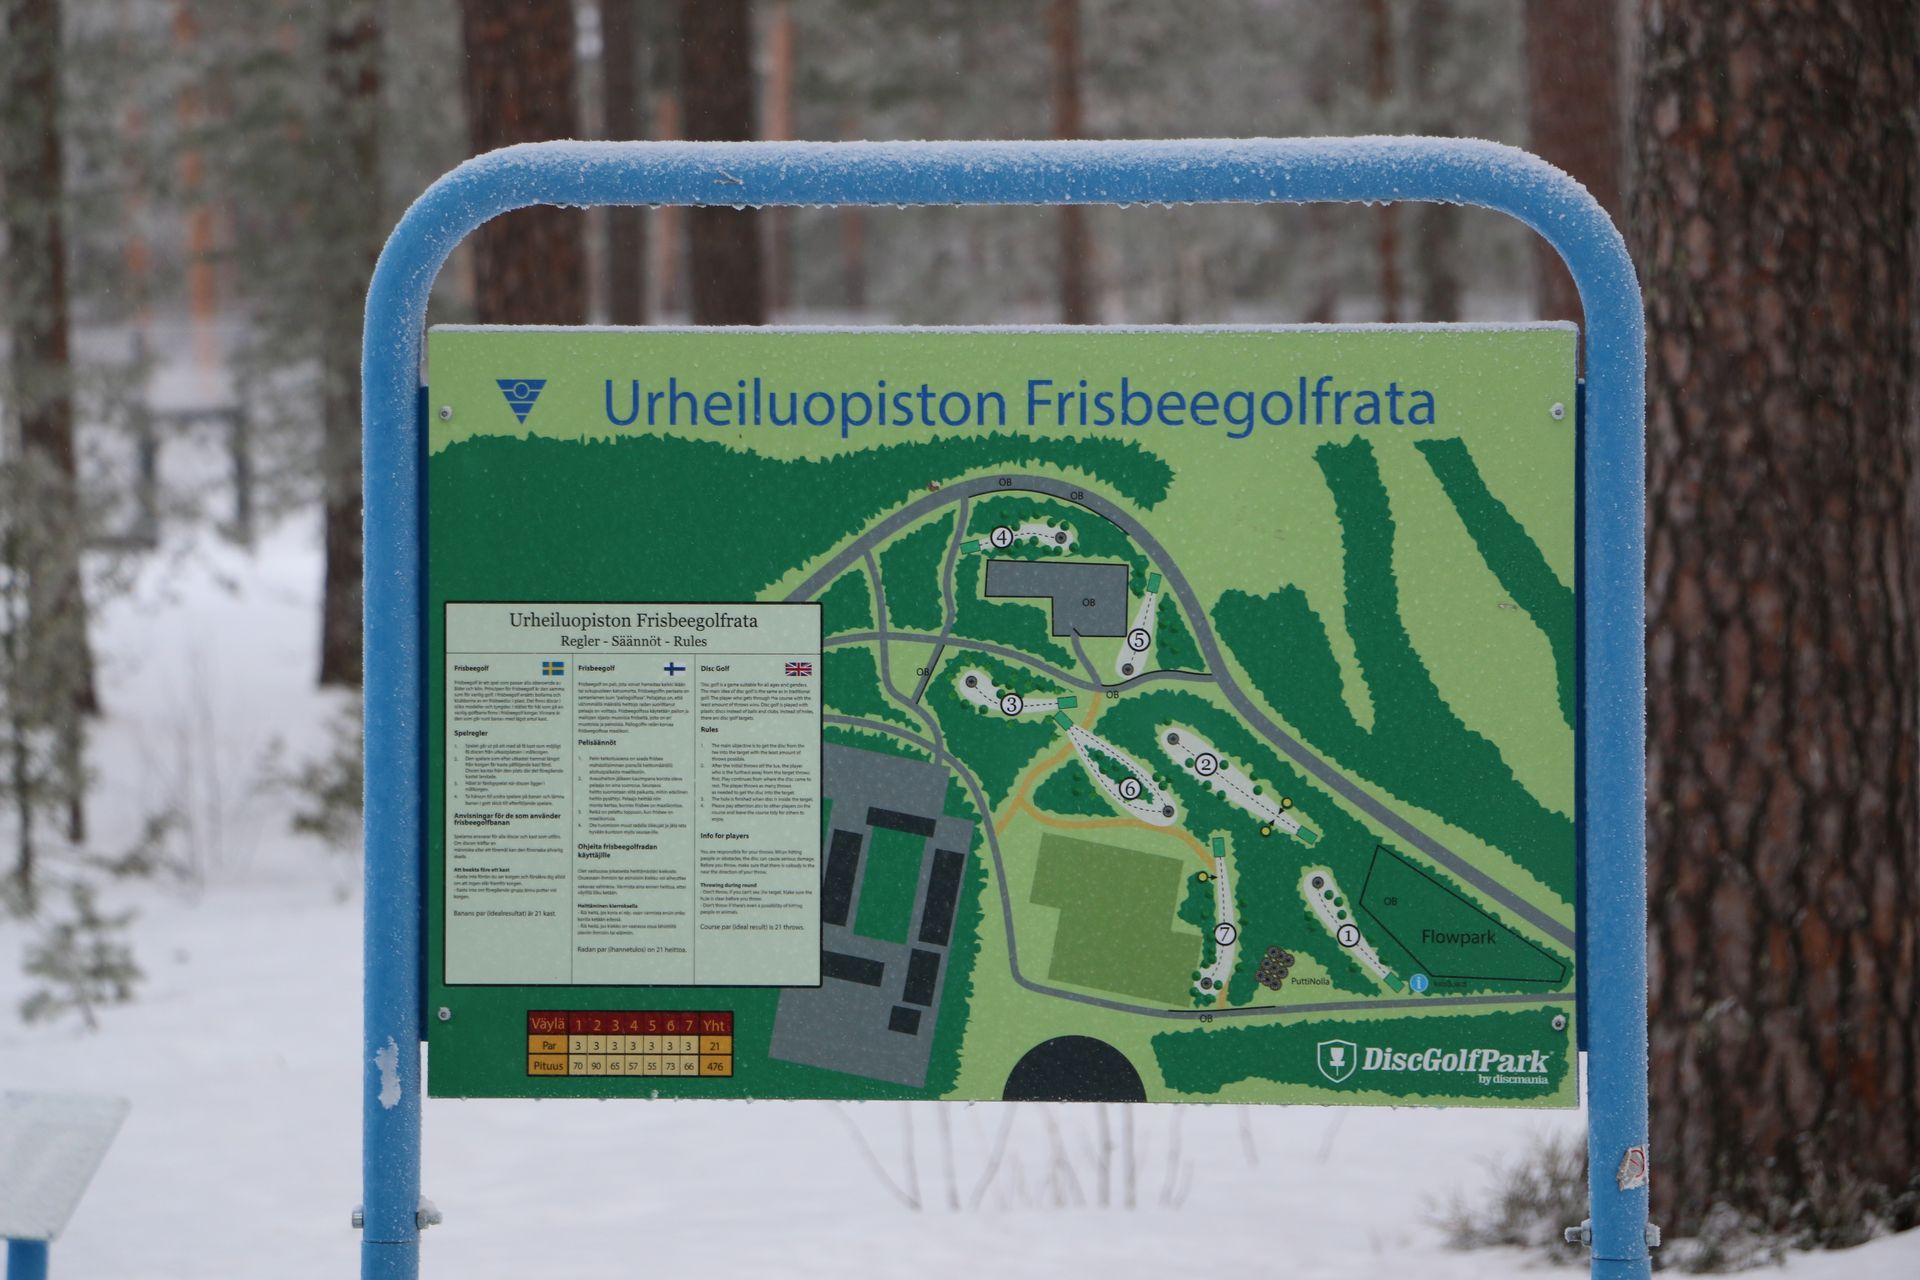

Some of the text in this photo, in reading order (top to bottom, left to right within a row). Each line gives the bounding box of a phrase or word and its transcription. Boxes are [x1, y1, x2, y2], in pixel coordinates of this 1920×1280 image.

[605, 376, 1435, 439] Urheiluopiston Frisbeegolfrata
[998, 478, 1012, 487] OB
[1070, 491, 1084, 501] OB
[996, 530, 1007, 545] 4
[1082, 598, 1096, 607] OB
[510, 612, 758, 631] Urheiluopiston Frisbeegolfrata
[561, 636, 600, 648] Regler
[612, 635, 661, 647] Säännöt
[674, 636, 707, 647] Rules
[1134, 633, 1145, 648] 5
[916, 667, 930, 676] OB
[1106, 690, 1119, 699] OB
[1006, 697, 1017, 712] 3
[1201, 759, 1211, 771] 2
[1125, 781, 1136, 796] 6
[1384, 897, 1397, 906] OB
[1220, 928, 1231, 942] 7
[1422, 929, 1496, 948] Flowpark
[531, 1017, 724, 1032] Väylä 1 2 3 4 5 6 7 Yht
[1200, 1015, 1213, 1023] OB
[542, 1042, 720, 1050] Par 3 3 3 3 3 3 3 21
[534, 1062, 723, 1070] Pituus 70 90 65 57 55 73 66 476
[1362, 1047, 1551, 1073] DiscGolfPark
[1478, 1074, 1548, 1085] by discmania
